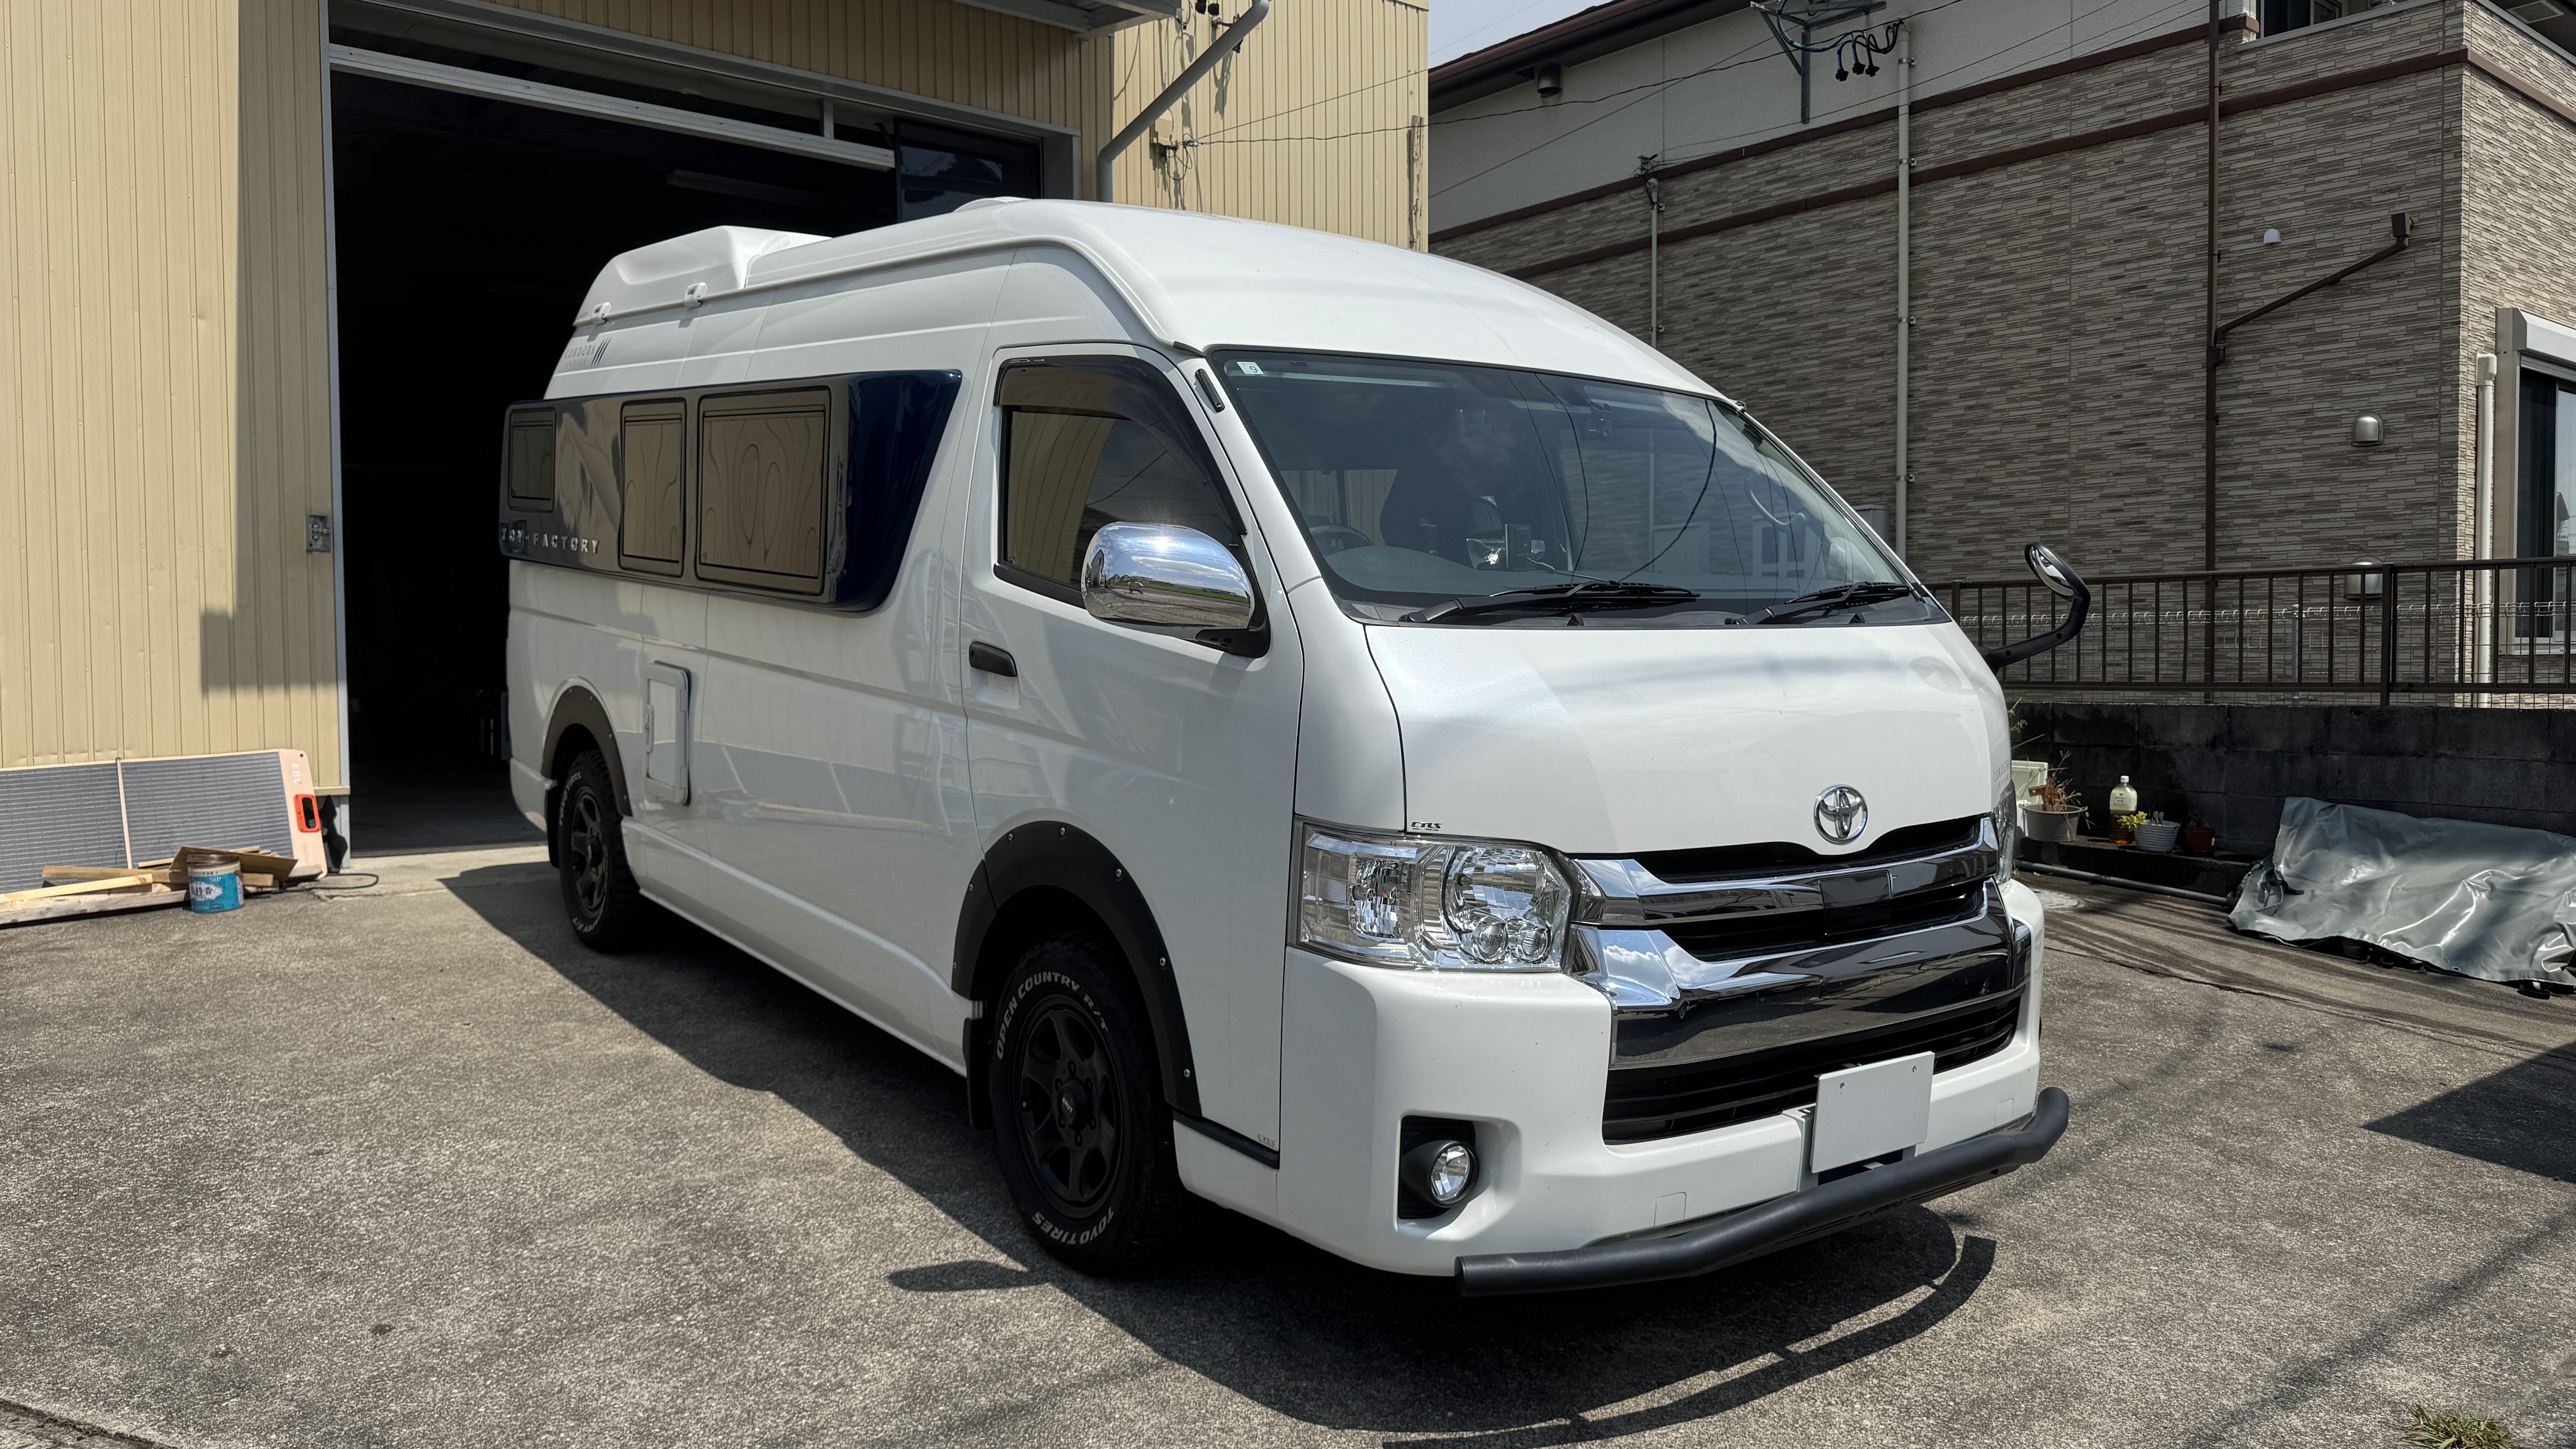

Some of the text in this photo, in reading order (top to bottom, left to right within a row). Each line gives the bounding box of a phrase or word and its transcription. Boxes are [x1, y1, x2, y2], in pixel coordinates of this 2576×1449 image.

[996, 971, 1109, 1060] OPEN COUNTRY R/T
